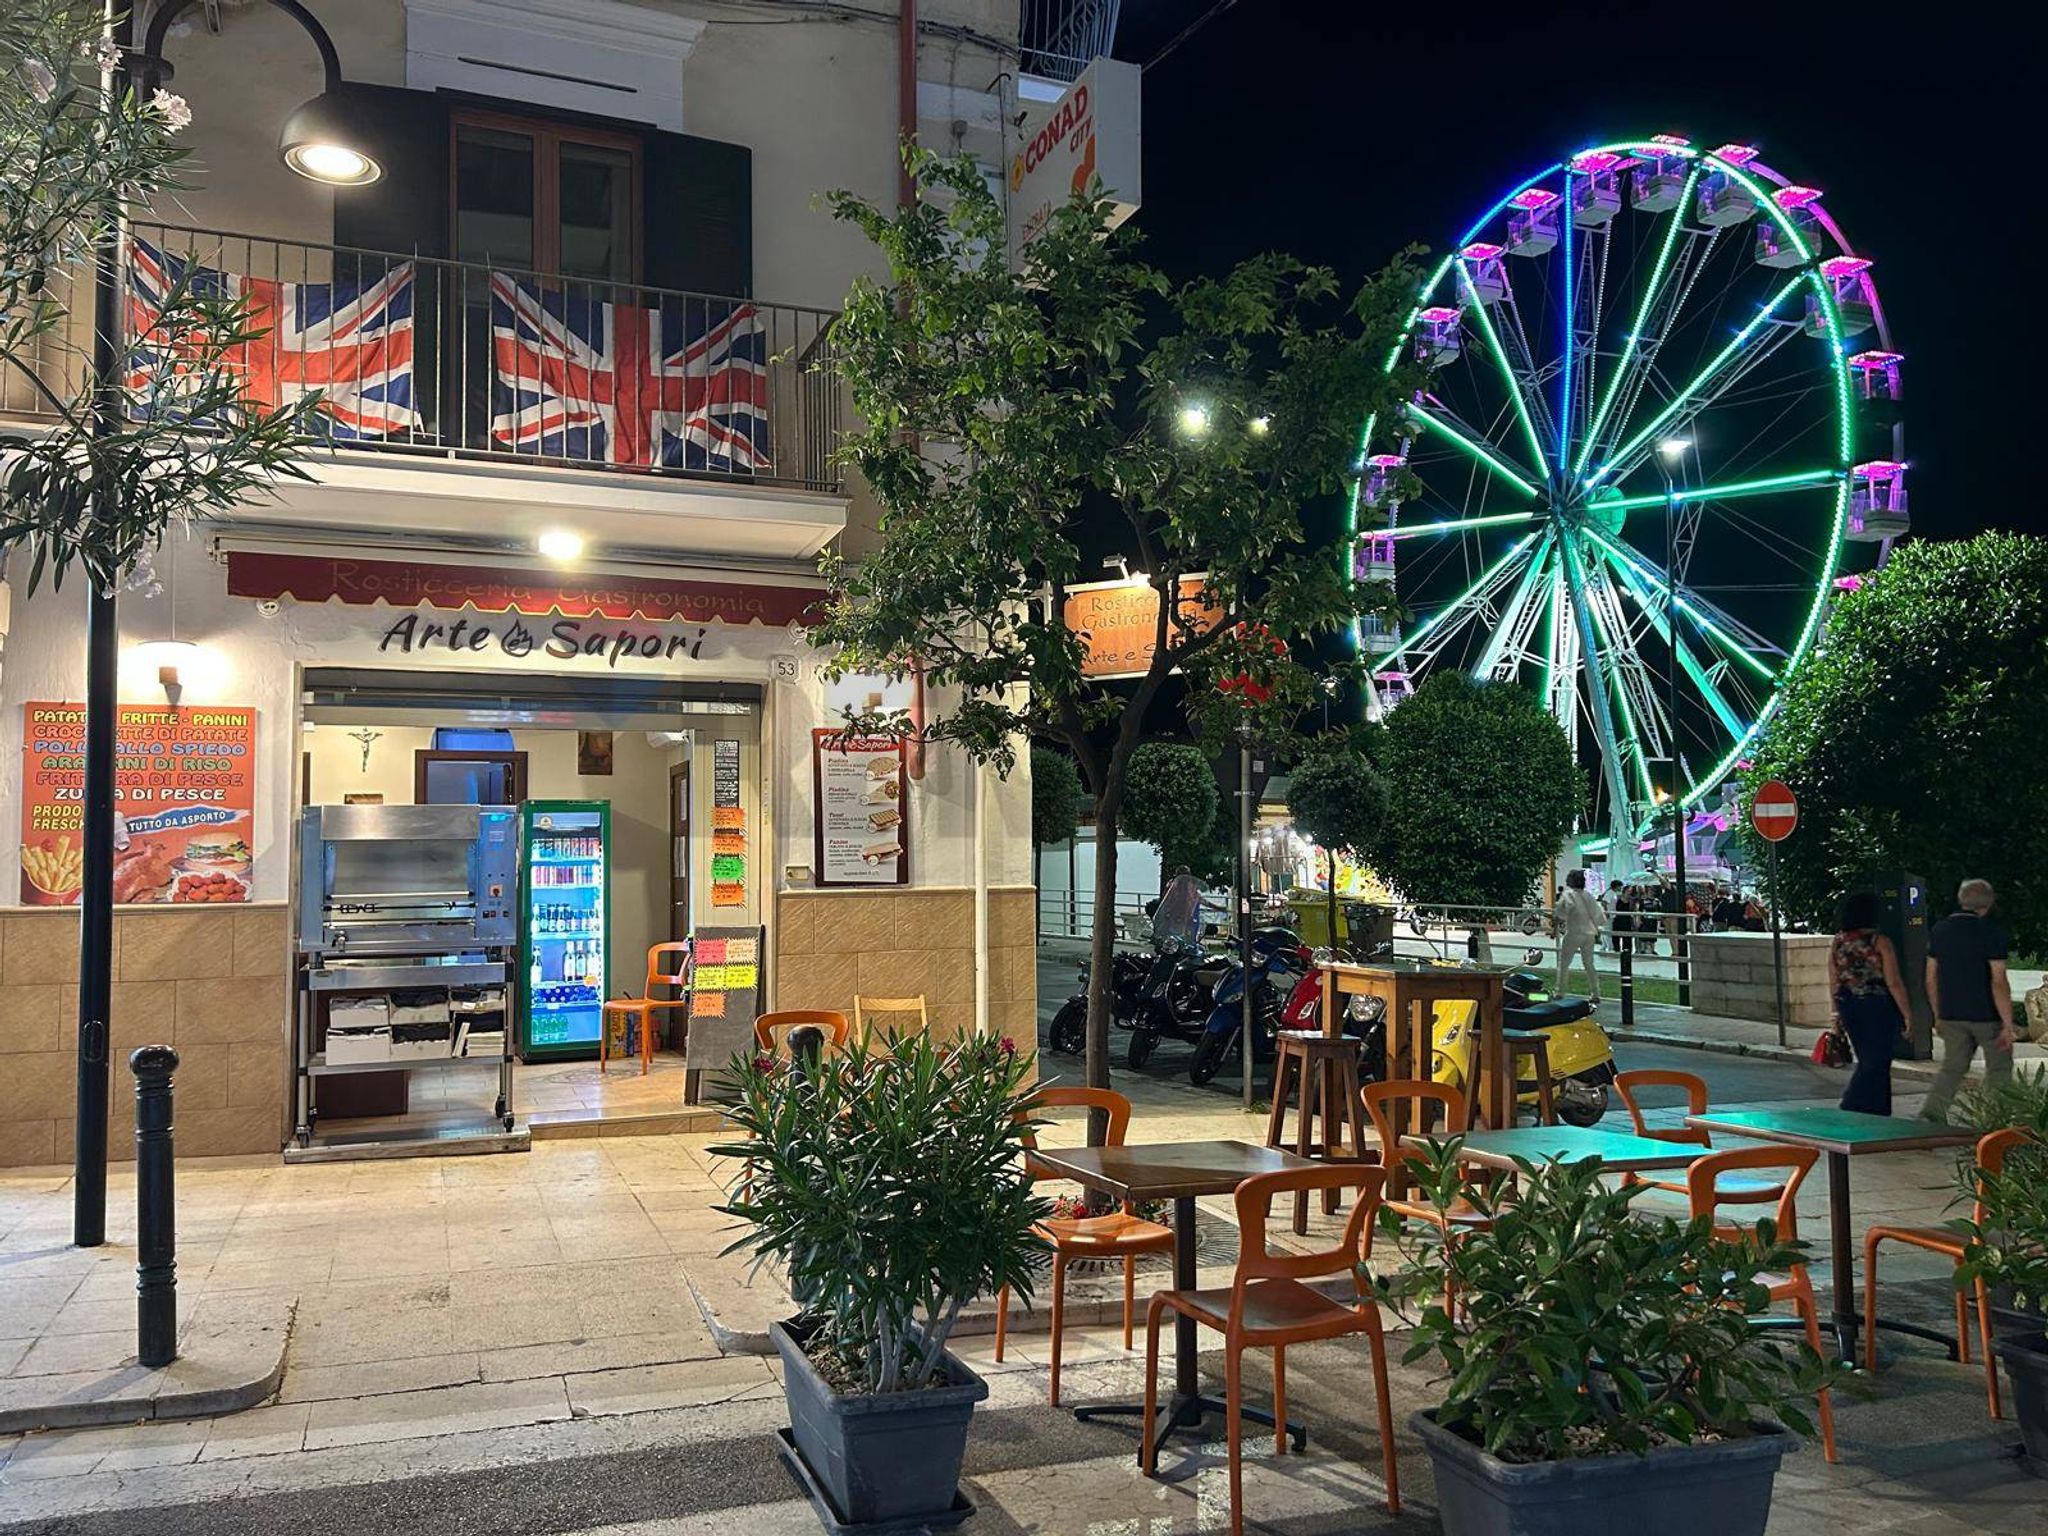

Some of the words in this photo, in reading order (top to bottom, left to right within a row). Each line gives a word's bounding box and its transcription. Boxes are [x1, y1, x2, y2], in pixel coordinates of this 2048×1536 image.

[1025, 85, 1088, 174] CONAD
[1070, 115, 1093, 152] CITY
[327, 561, 532, 600] Rosticceria
[377, 614, 490, 654] Arte
[545, 619, 707, 669] Sapori
[778, 661, 796, 676] 53
[33, 710, 88, 723] PATAT
[121, 712, 179, 725] FRITTE
[193, 714, 248, 726] PANINI
[158, 728, 176, 739] DI
[181, 729, 248, 741] PATATE
[34, 740, 88, 753] POLL
[171, 743, 246, 755] SPIEDO
[154, 757, 175, 771] DI
[181, 758, 232, 771] RISO
[150, 773, 171, 786] DI
[177, 773, 243, 787] PESCE
[132, 788, 152, 800] DI
[160, 788, 225, 800] PESCE
[129, 819, 162, 832] TUTTO
[164, 817, 178, 827] DA
[181, 811, 226, 825] ASPORTO
[1909, 887, 1919, 905] P
